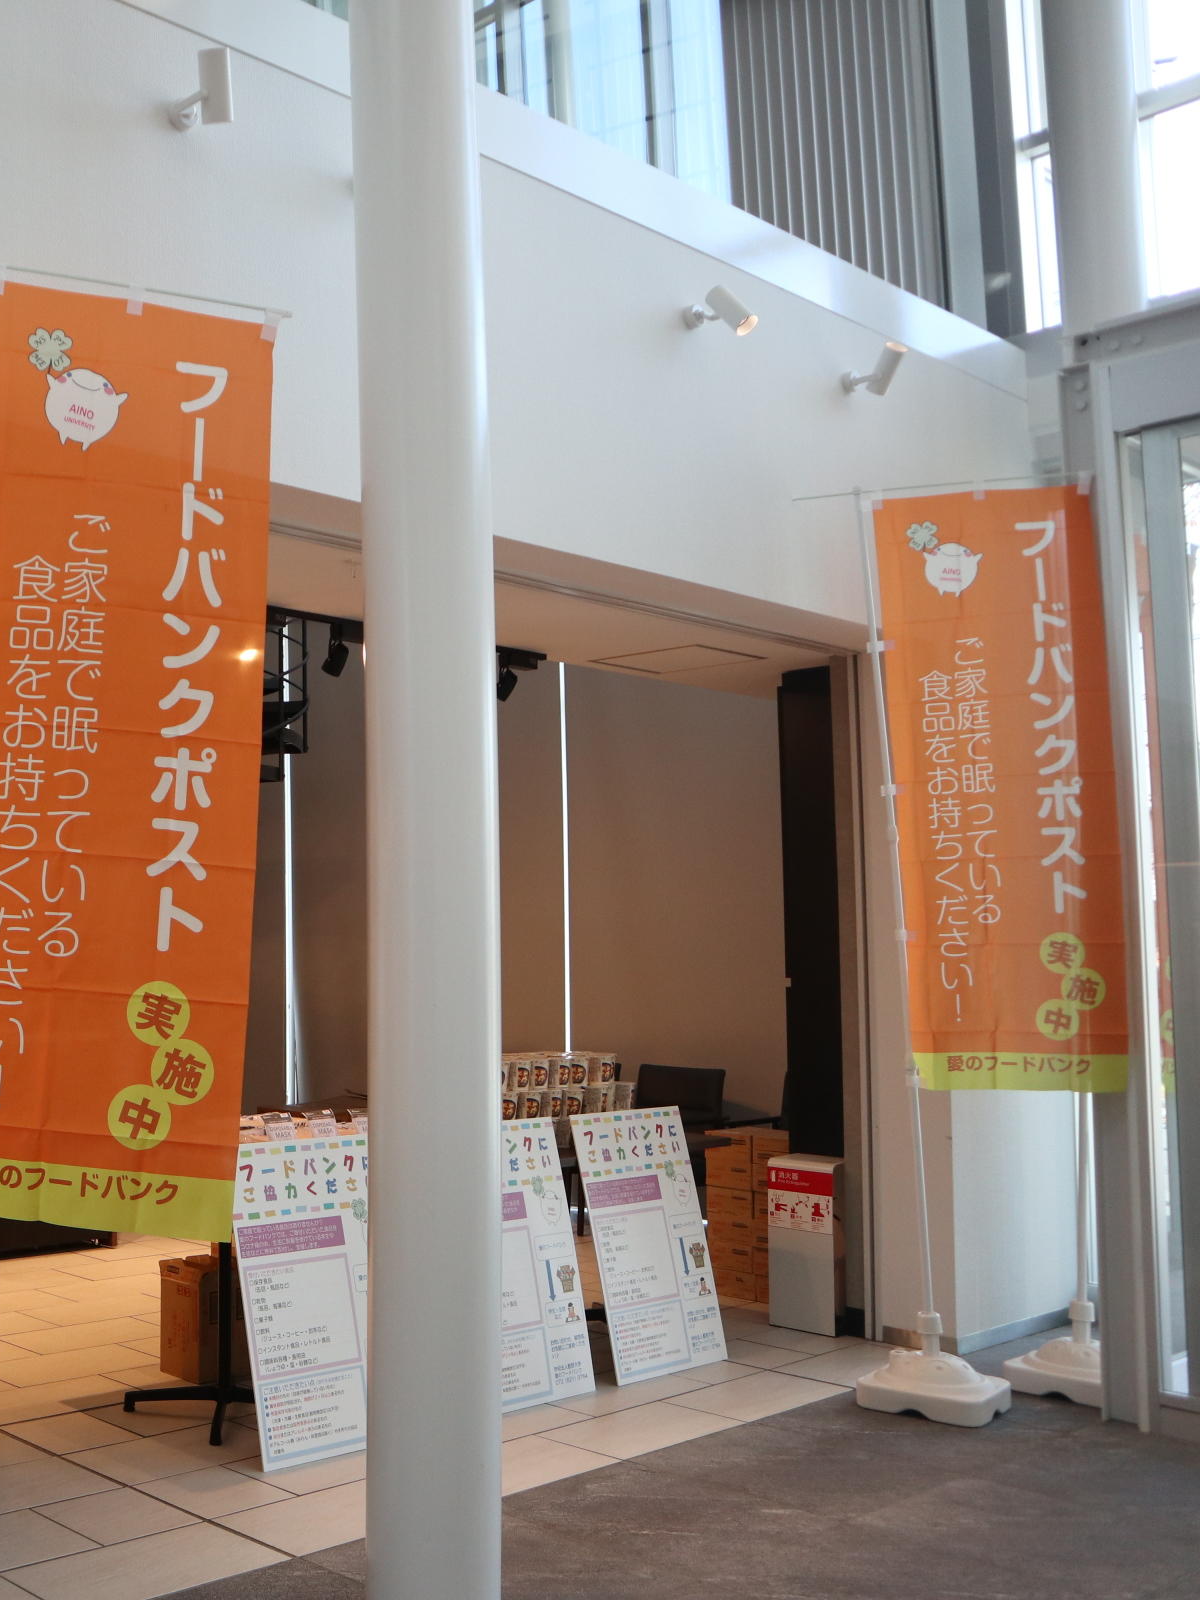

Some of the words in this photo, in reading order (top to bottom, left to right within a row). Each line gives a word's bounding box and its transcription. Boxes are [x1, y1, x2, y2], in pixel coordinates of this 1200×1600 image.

[63, 416, 96, 432] UNIVERSITY
[69, 404, 95, 420] AINO
[146, 361, 228, 952] フードバンクポスト
[1014, 520, 1088, 914] フードバンクポスト
[38, 514, 111, 957] ご家庭で眠っている
[954, 636, 1002, 924] ご家庭で眠っている
[918, 670, 974, 1022] 食品をお持ちください!
[1044, 939, 1098, 1035] 実施中
[118, 991, 206, 1140] 実施中
[947, 1056, 1091, 1075] 愛のフードバンク
[243, 1175, 368, 1203] ご協力くださ
